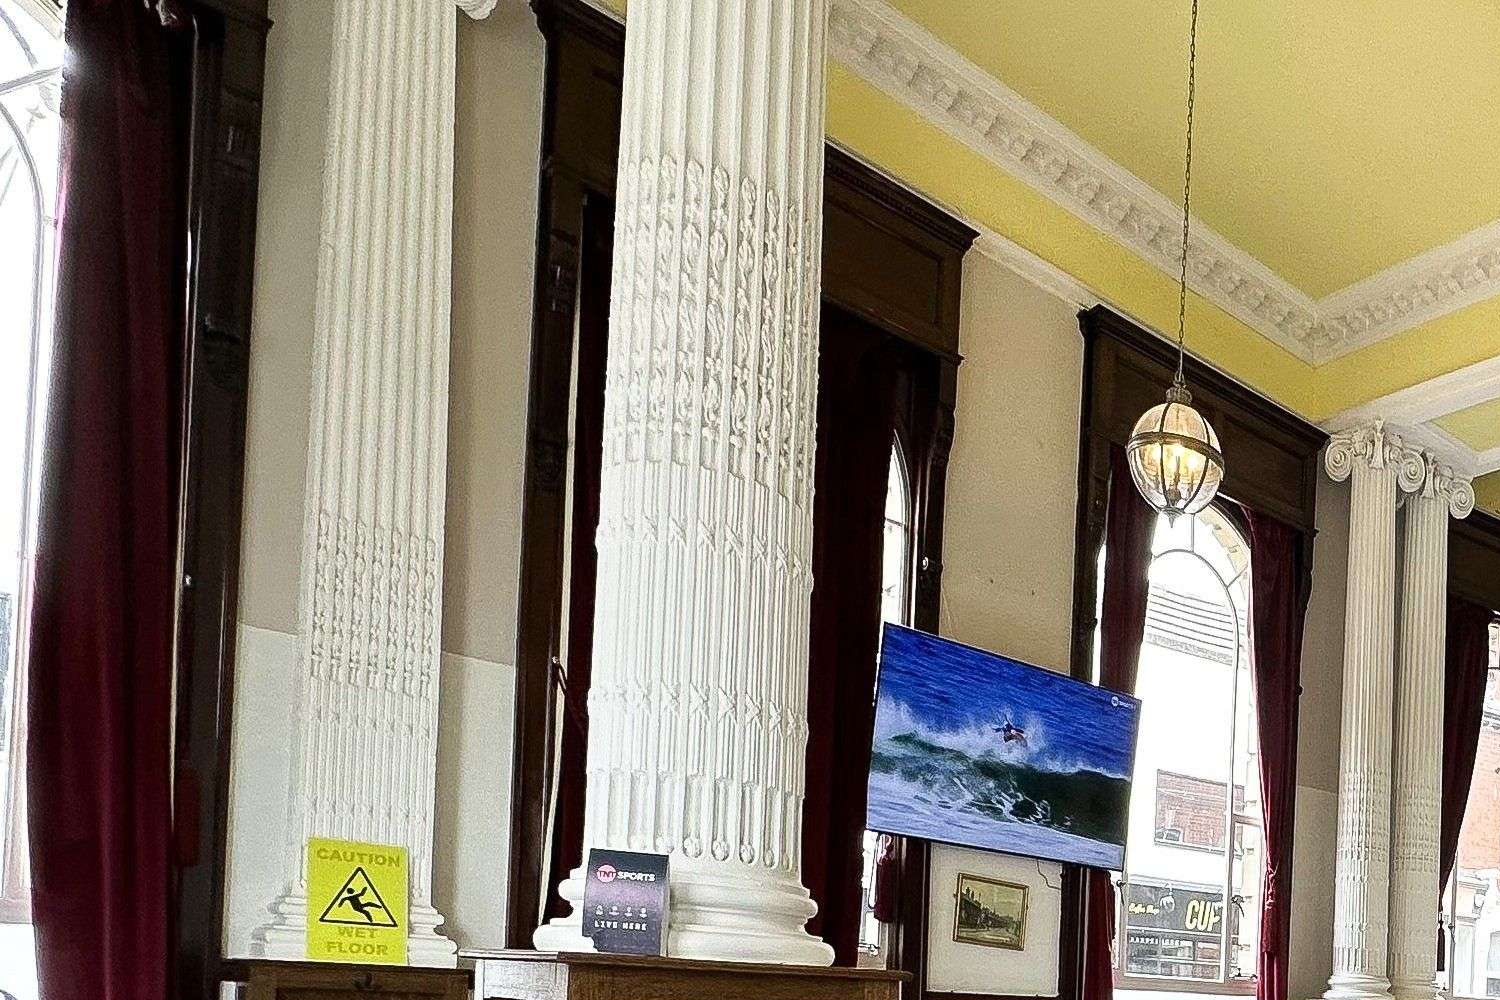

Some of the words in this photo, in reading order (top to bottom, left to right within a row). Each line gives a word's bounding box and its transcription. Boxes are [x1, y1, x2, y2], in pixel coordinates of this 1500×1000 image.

[316, 847, 400, 867] CAUTION
[617, 871, 656, 882] SPORTS
[594, 920, 618, 929] LIVE
[622, 922, 648, 931] HERE
[337, 926, 378, 938] WET
[326, 941, 388, 955] FLOOR
